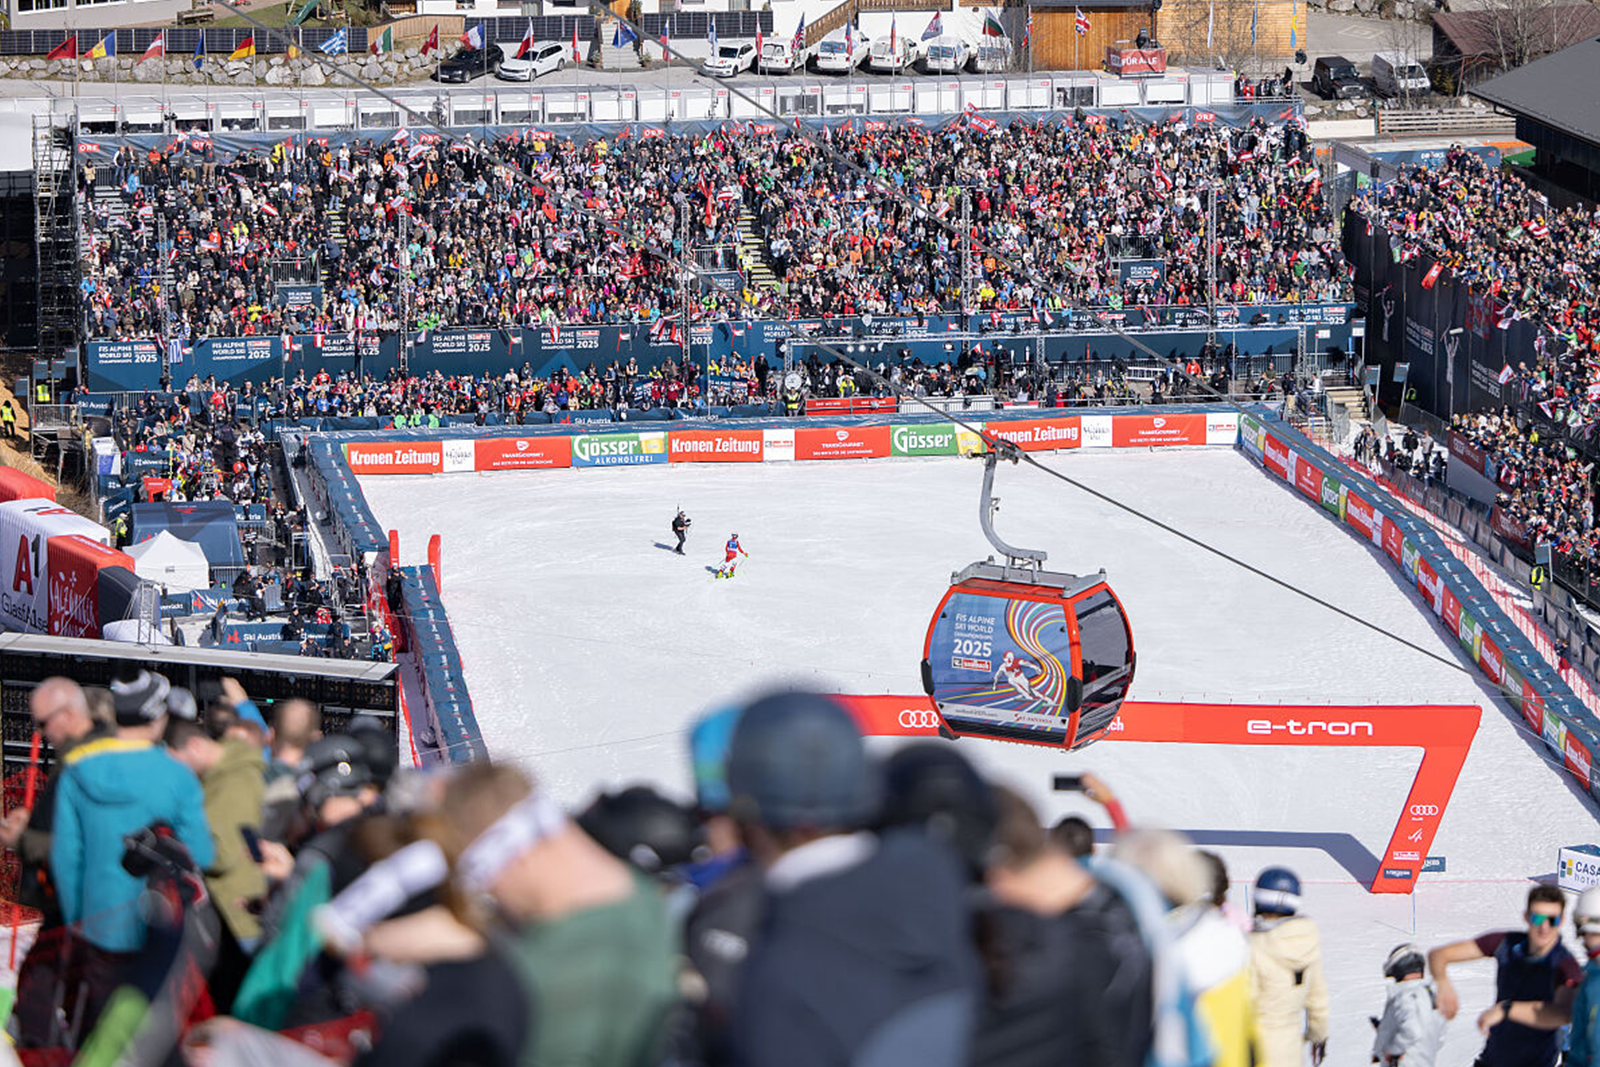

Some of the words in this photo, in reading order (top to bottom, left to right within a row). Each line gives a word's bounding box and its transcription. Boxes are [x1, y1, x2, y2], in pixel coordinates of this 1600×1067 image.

[1122, 56, 1137, 66] FÜR
[576, 340, 599, 348] 2025
[691, 336, 713, 345] 2025
[468, 344, 491, 352] 2025
[134, 354, 158, 364] 2025
[248, 350, 270, 360] 2025
[1034, 426, 1078, 440] Zeitung
[672, 438, 714, 453] Kronen
[714, 437, 760, 454] Zeitung
[894, 427, 953, 453] Gösser
[574, 434, 638, 462] Gösser
[350, 450, 393, 465] Kronen
[394, 448, 440, 466] Zeitung
[594, 455, 653, 464] ALKOHOLFREI
[12, 534, 40, 596] A1
[956, 613, 967, 622] FIS
[968, 615, 996, 626] ALPINE
[954, 622, 966, 630] SKI
[967, 624, 994, 634] WORLD
[243, 633, 256, 642] Ski
[257, 632, 284, 641] Austri
[952, 638, 992, 658] 2025
[1247, 719, 1373, 736] e-tron
